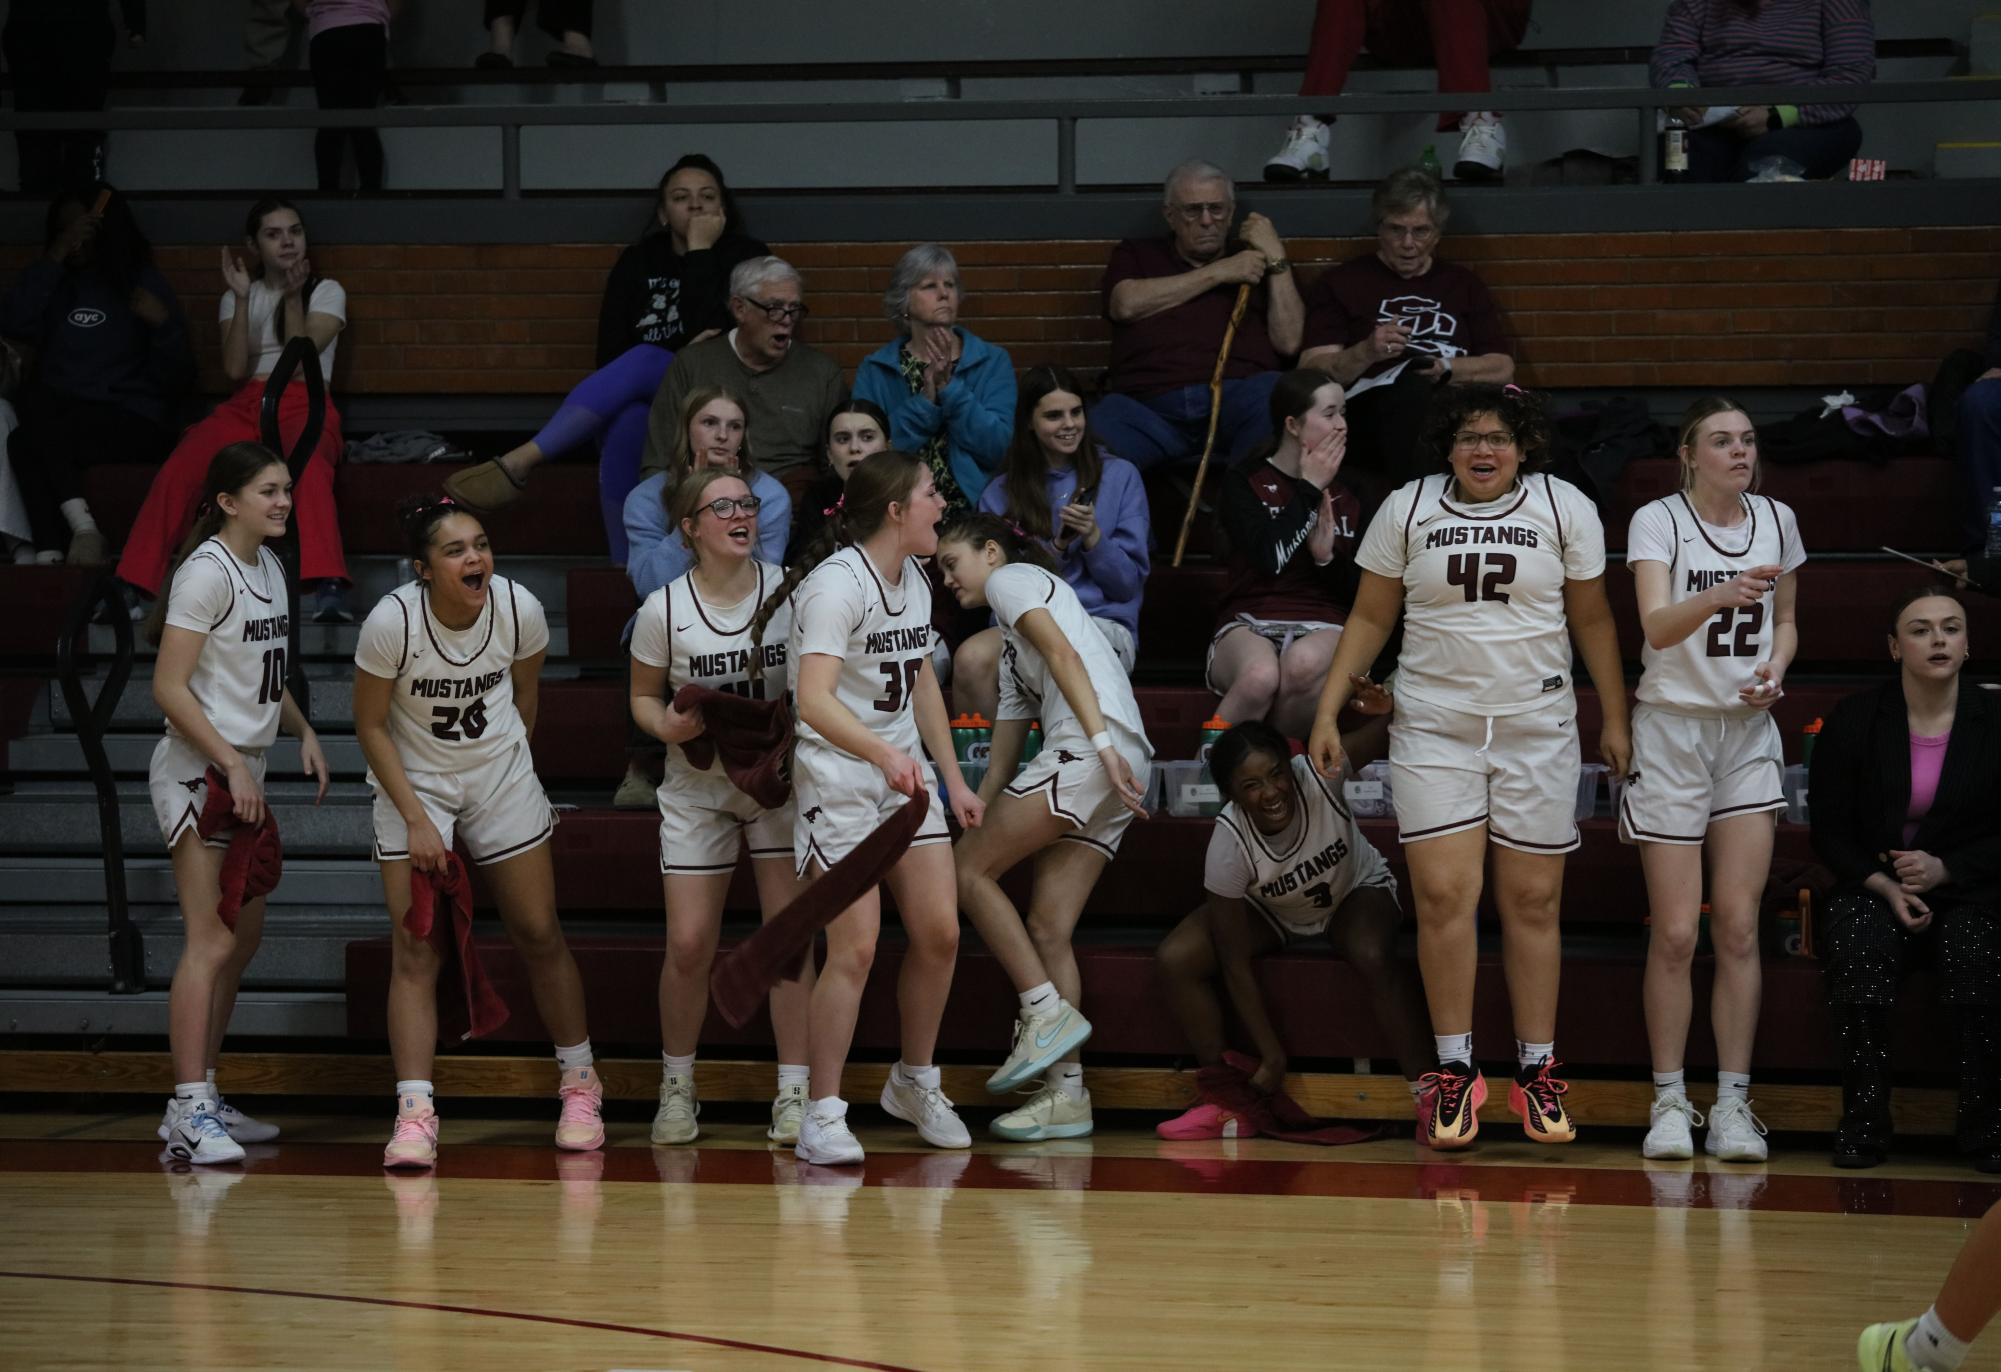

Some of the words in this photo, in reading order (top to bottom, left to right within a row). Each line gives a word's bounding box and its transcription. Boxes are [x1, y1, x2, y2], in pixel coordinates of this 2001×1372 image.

[1425, 526, 1538, 549] MUSTANGS
[1447, 552, 1517, 604] 42
[1687, 569, 1776, 593] MUSTS
[243, 614, 288, 643] MUSTANG
[865, 624, 930, 654] MUSTANG
[1707, 602, 1764, 657] 22
[258, 647, 286, 705] 10
[410, 667, 506, 699] MUSTANGS
[1261, 838, 1348, 898] MUSTANGS
